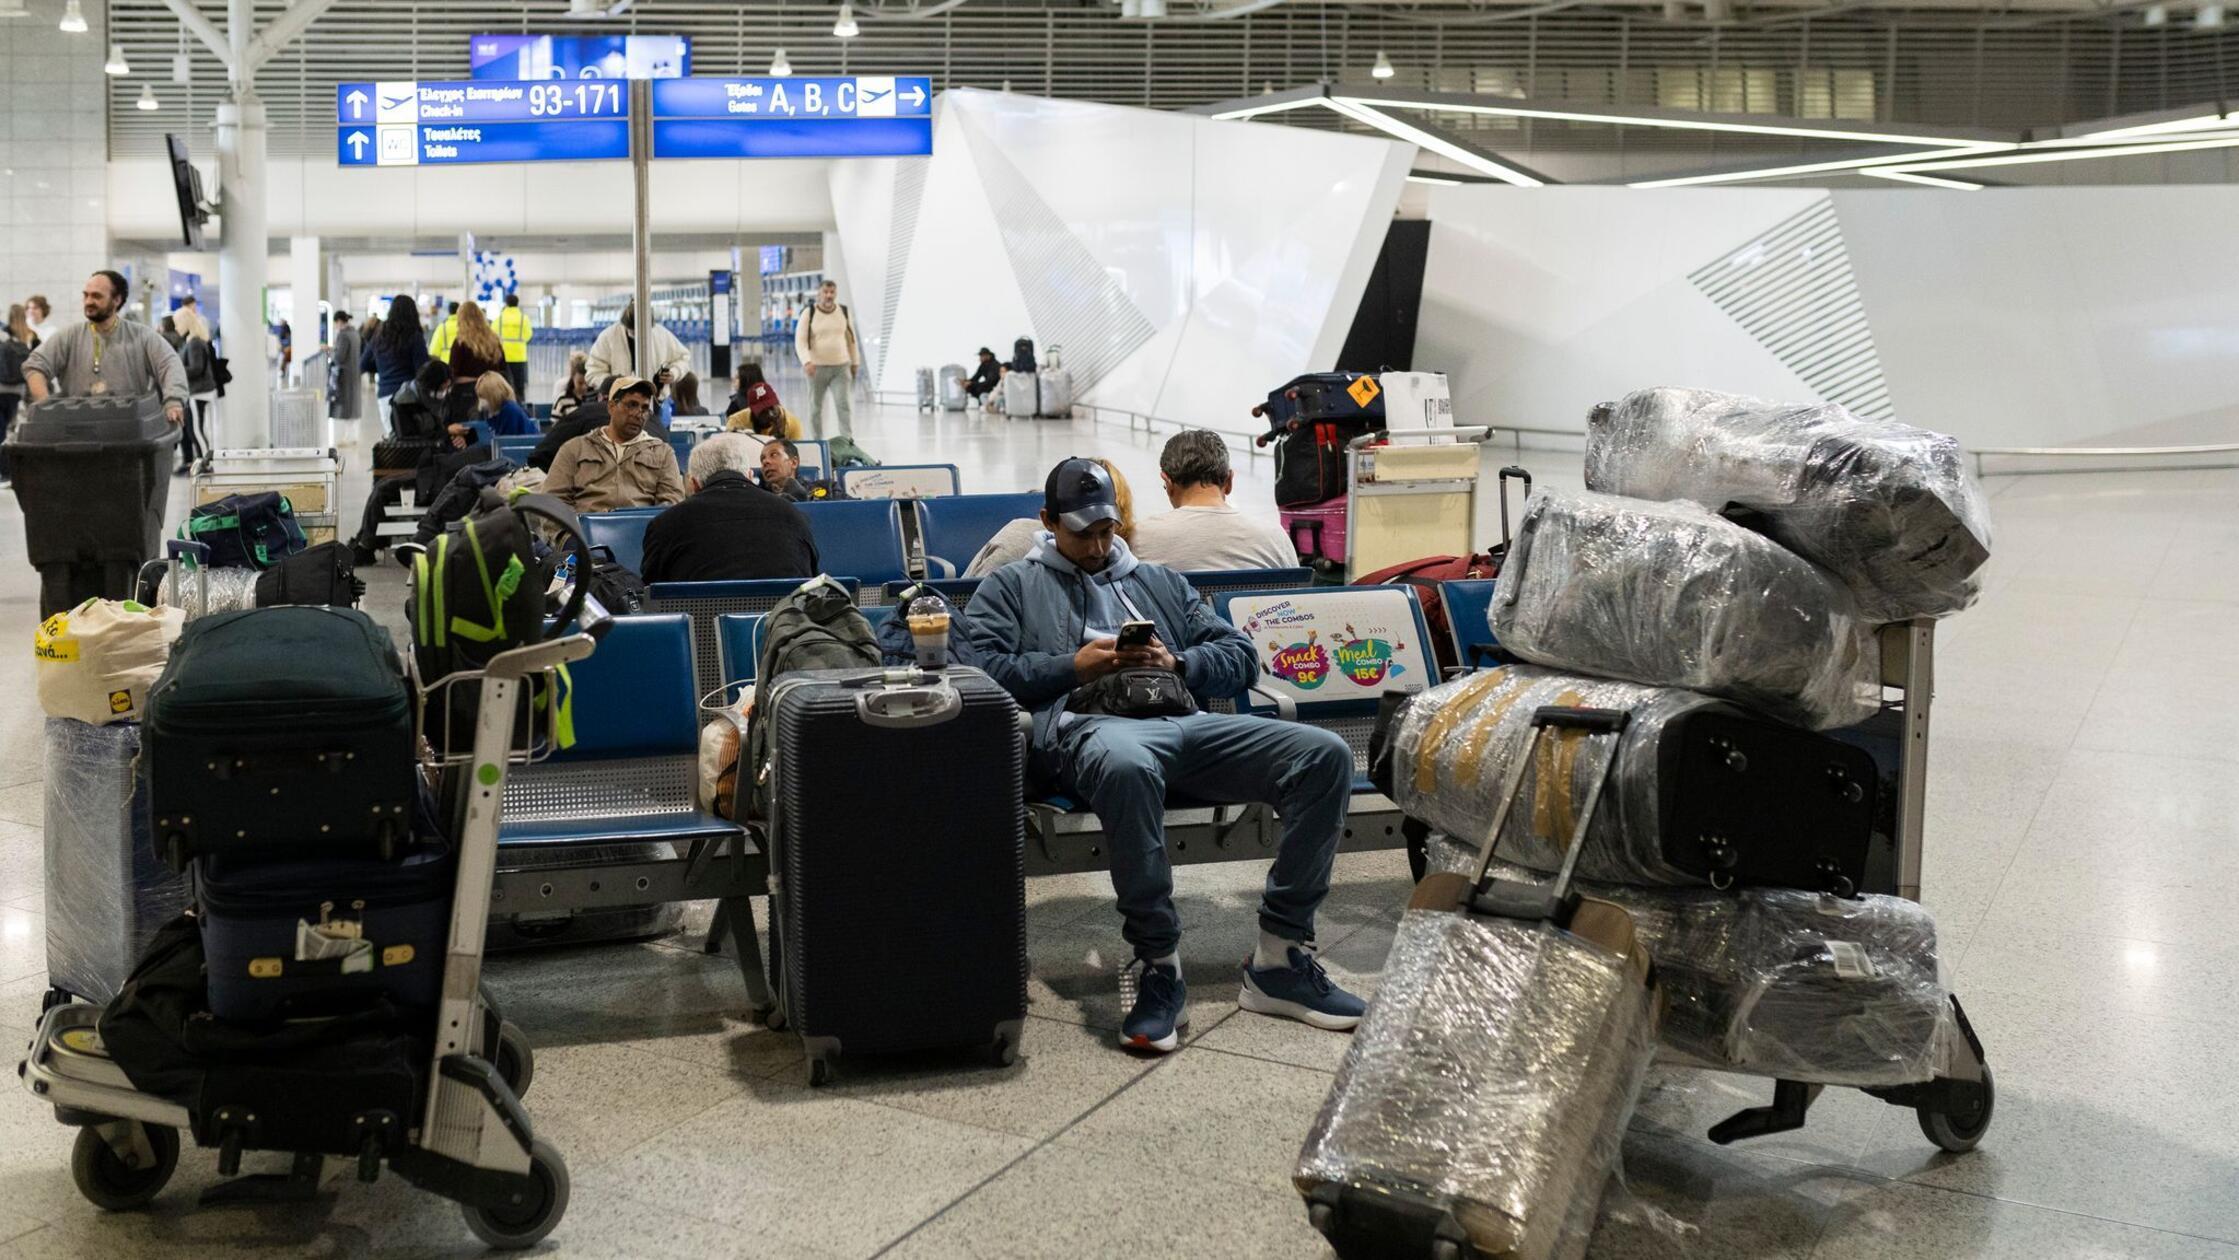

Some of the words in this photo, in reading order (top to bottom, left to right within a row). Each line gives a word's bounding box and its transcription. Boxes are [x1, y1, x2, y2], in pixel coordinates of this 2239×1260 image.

[529, 83, 619, 116] 93-171
[768, 83, 796, 116] A,
[804, 83, 830, 116] B,
[837, 82, 856, 113] C
[420, 104, 464, 118] Check-in
[423, 126, 482, 142] Τουαλέτες
[424, 144, 458, 158] Toilets
[1255, 600, 1291, 619] DISCOVER
[1277, 608, 1296, 618] NOW
[1264, 617, 1281, 626] THE
[1282, 613, 1315, 624] COMBOS
[1280, 645, 1320, 669] Snack
[1338, 639, 1377, 664] Meal
[1293, 662, 1321, 670] COMBO
[1355, 658, 1383, 666] COMBO
[1297, 671, 1317, 683] 9€
[1354, 667, 1379, 680] 15€
